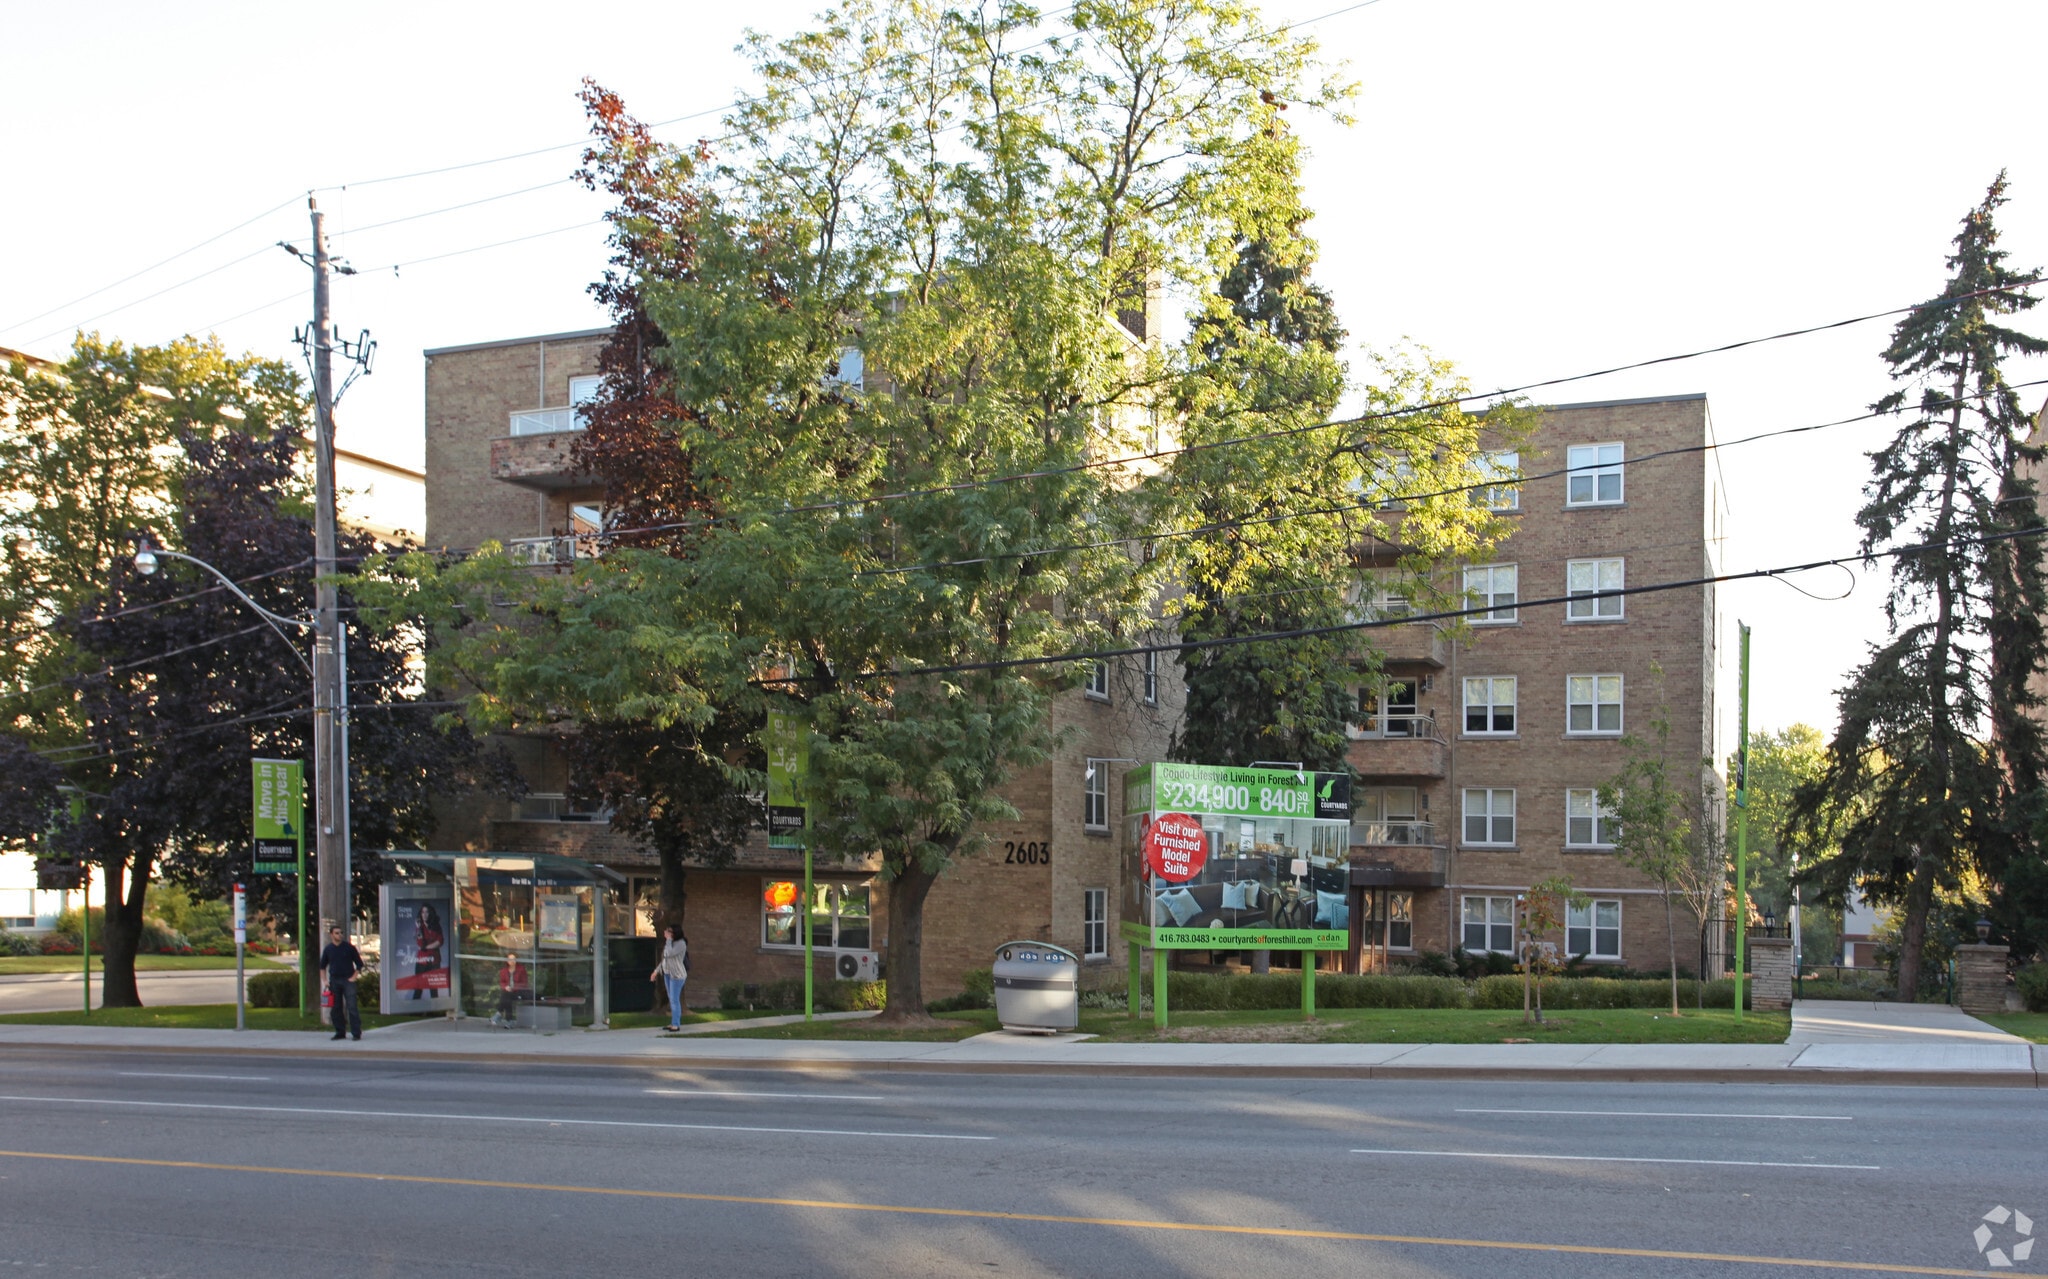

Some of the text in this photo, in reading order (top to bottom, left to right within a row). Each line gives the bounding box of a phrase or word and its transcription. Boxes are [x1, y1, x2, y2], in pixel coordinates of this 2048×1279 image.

[1230, 772, 1256, 785] Living
[1258, 774, 1266, 784] in
[1268, 774, 1293, 786] Forest
[259, 764, 272, 818] Move in
[274, 765, 290, 825] this year
[1163, 781, 1249, 813] $234,900
[1261, 787, 1296, 813] 840
[1297, 802, 1310, 814] FT.
[1321, 801, 1348, 809] COURTYARDS
[773, 816, 801, 825] COURTYARDS
[1160, 820, 1198, 838] Visit our
[1154, 833, 1200, 852] Furnished
[259, 846, 293, 855] COURTYARDS
[1004, 841, 1050, 865] 2603
[1161, 847, 1191, 863] Model
[1164, 861, 1188, 875] Suite
[1159, 934, 1313, 945] 416.783.0483 courtyardsofforesthill.com
